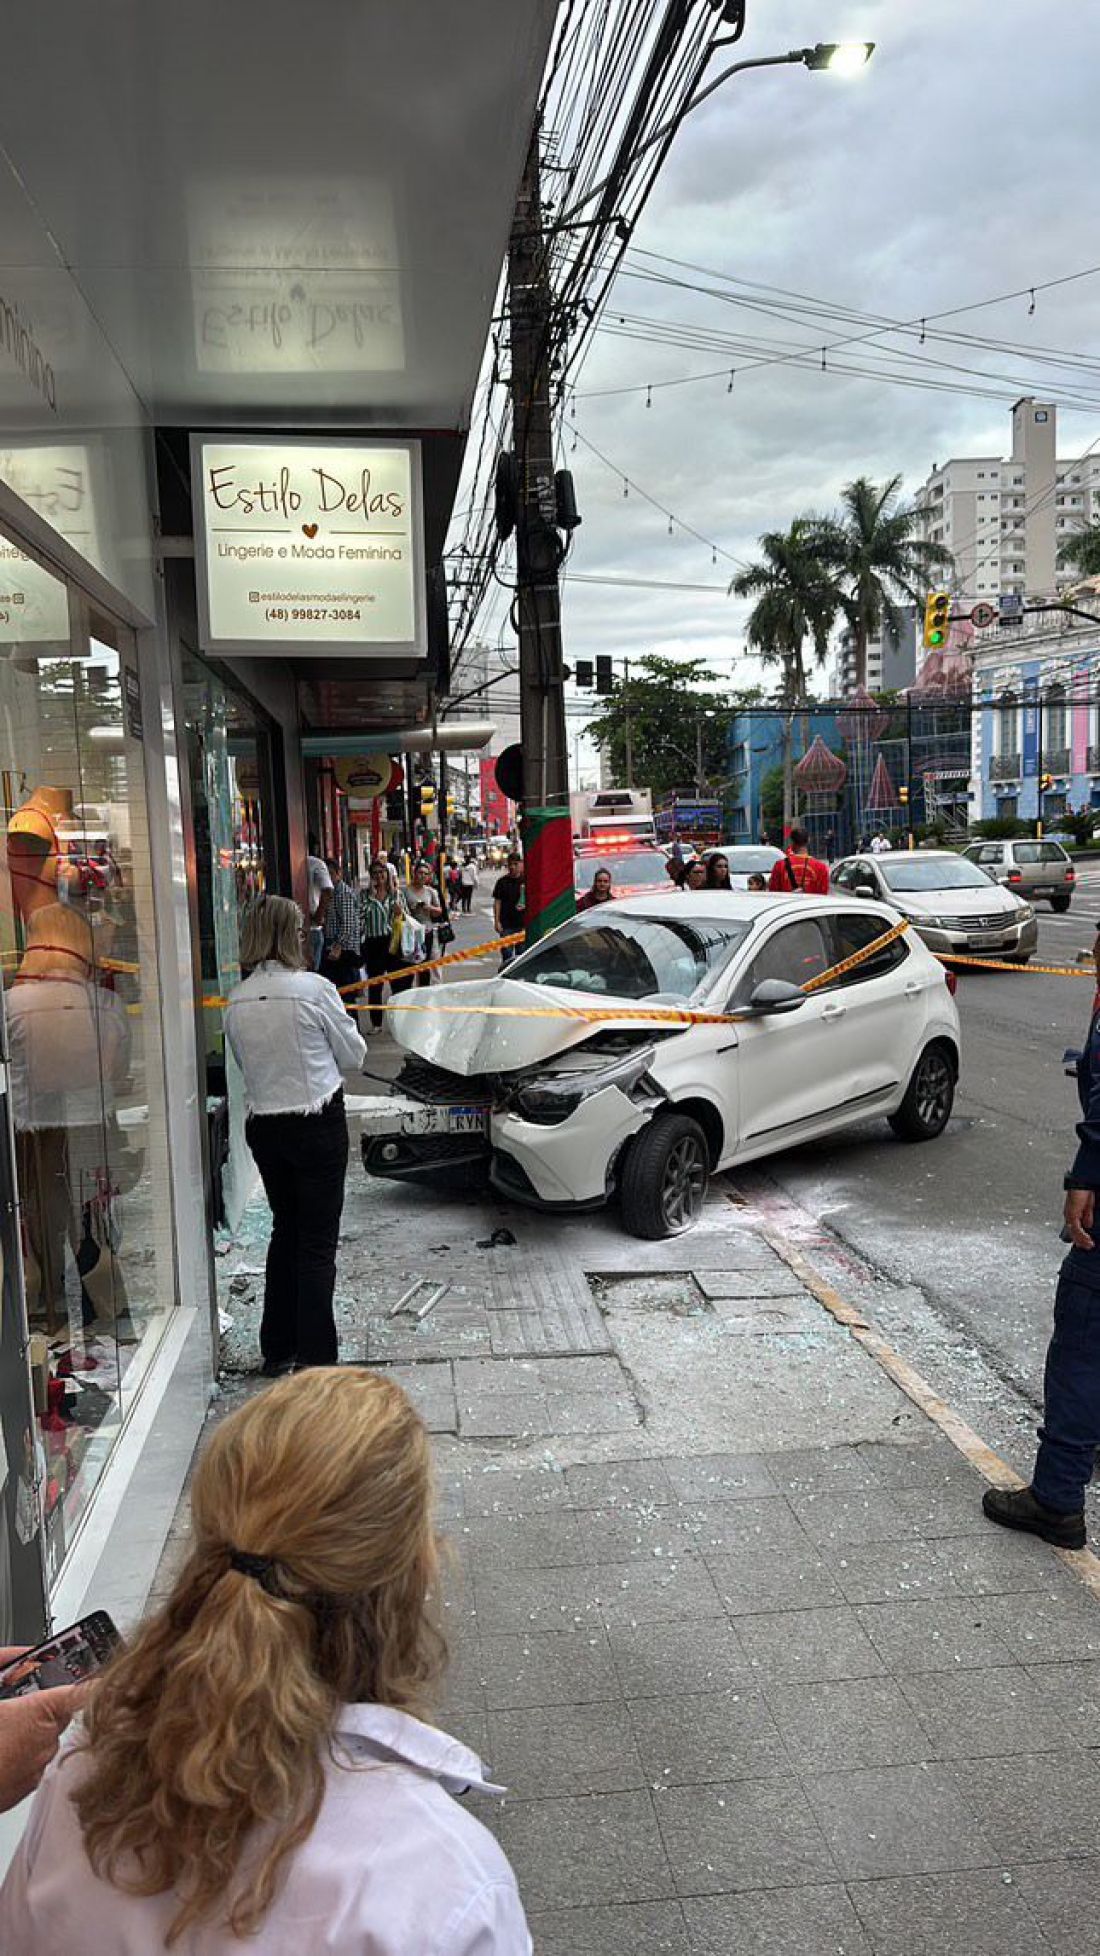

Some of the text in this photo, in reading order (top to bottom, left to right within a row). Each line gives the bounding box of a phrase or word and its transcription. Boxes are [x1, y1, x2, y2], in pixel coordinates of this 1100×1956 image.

[210, 465, 404, 521] Estilo Delas
[218, 543, 401, 560] Lingerie e Moda Feminina
[265, 608, 361, 621] (48) 99827-3084
